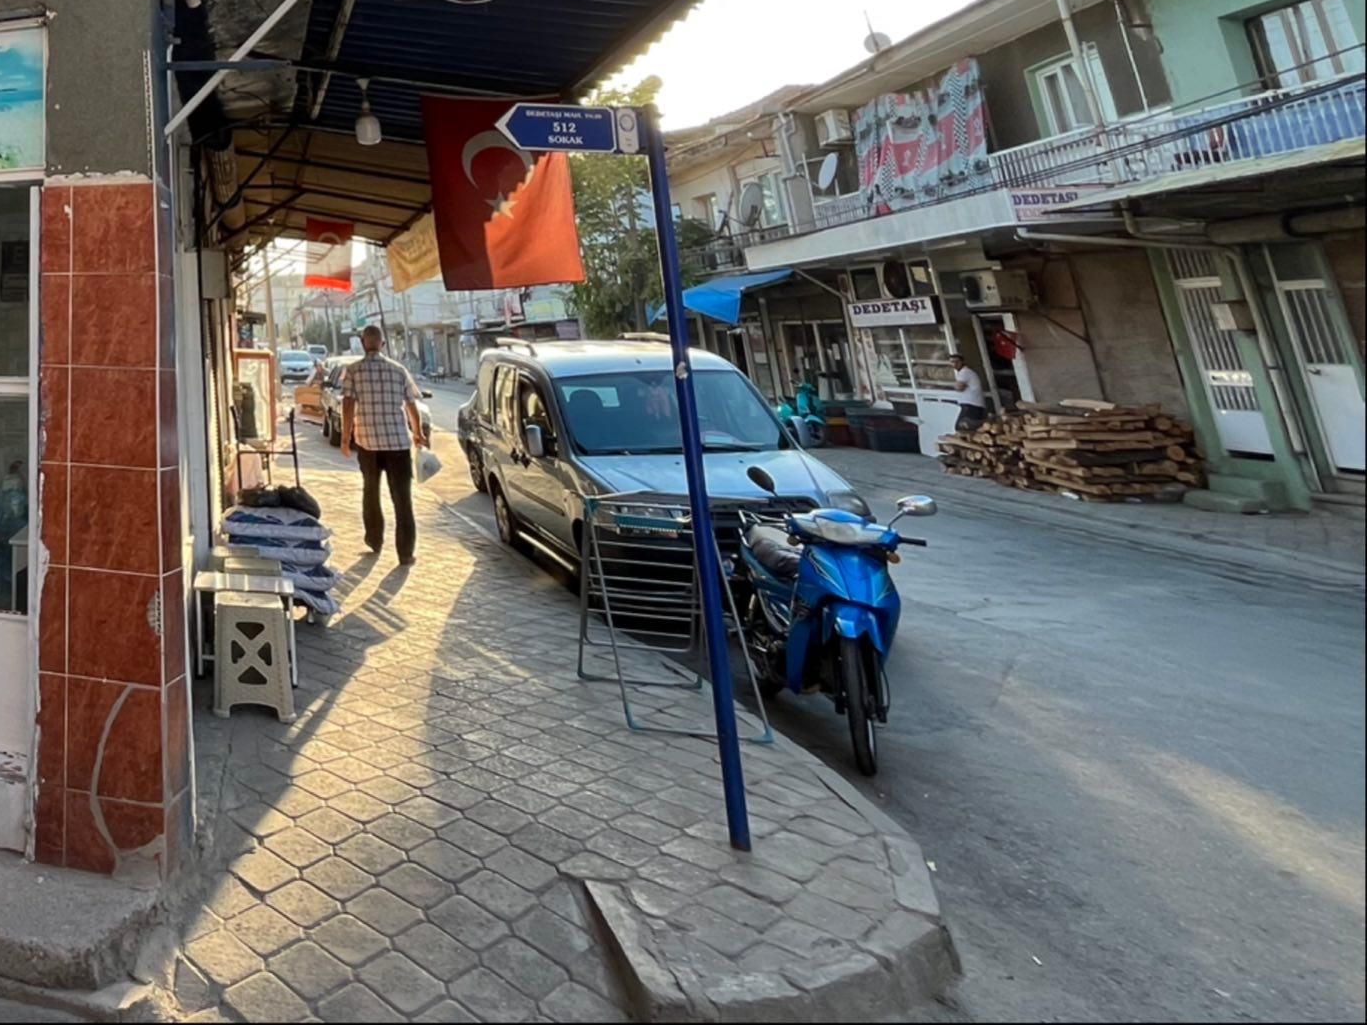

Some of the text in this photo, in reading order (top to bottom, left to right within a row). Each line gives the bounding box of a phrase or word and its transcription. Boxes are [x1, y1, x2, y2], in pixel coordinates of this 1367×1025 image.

[553, 122, 577, 133] 512
[548, 135, 584, 145] SOKAK
[852, 299, 927, 315] DEDETAŞI
